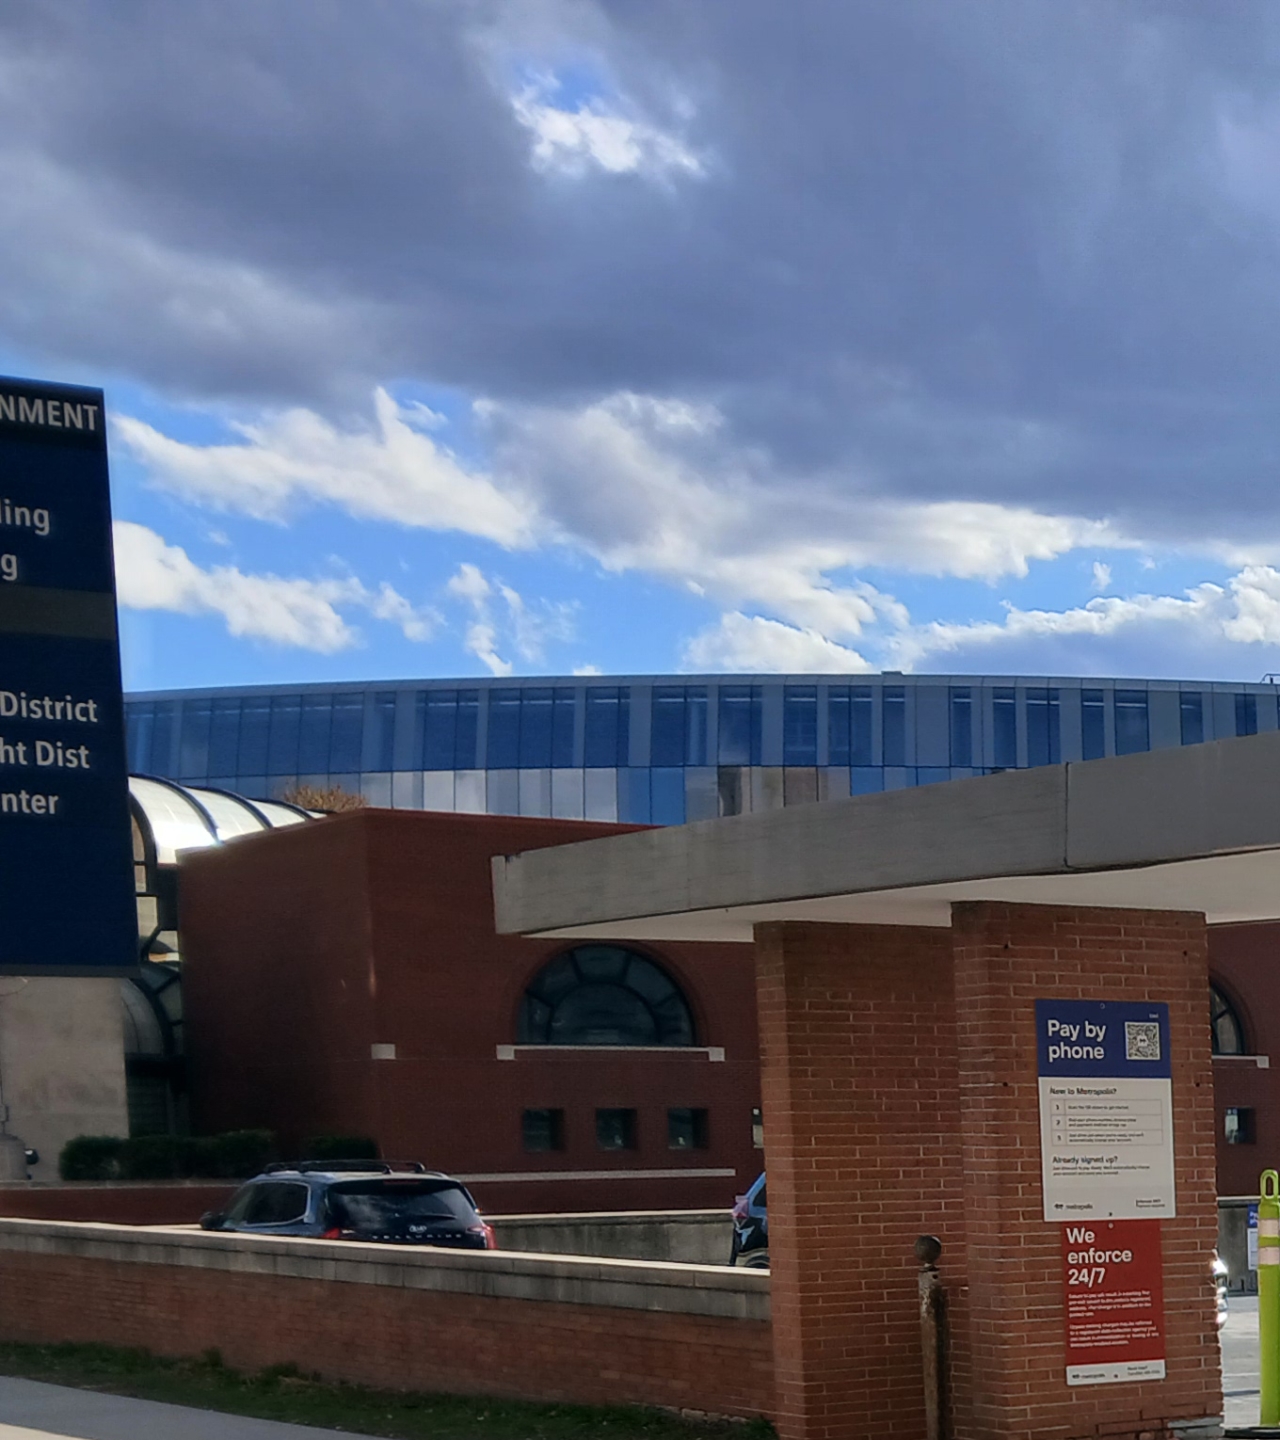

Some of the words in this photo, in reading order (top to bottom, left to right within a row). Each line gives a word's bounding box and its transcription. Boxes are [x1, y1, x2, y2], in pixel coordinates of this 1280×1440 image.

[0, 690, 98, 722] District
[35, 740, 90, 768] Dist
[1047, 1019, 1080, 1041] Pay
[1085, 1020, 1106, 1042] by
[1049, 1041, 1104, 1063] phone
[1066, 1226, 1095, 1244] We
[1067, 1247, 1132, 1264] enforce
[1068, 1267, 1106, 1288] 24/7
